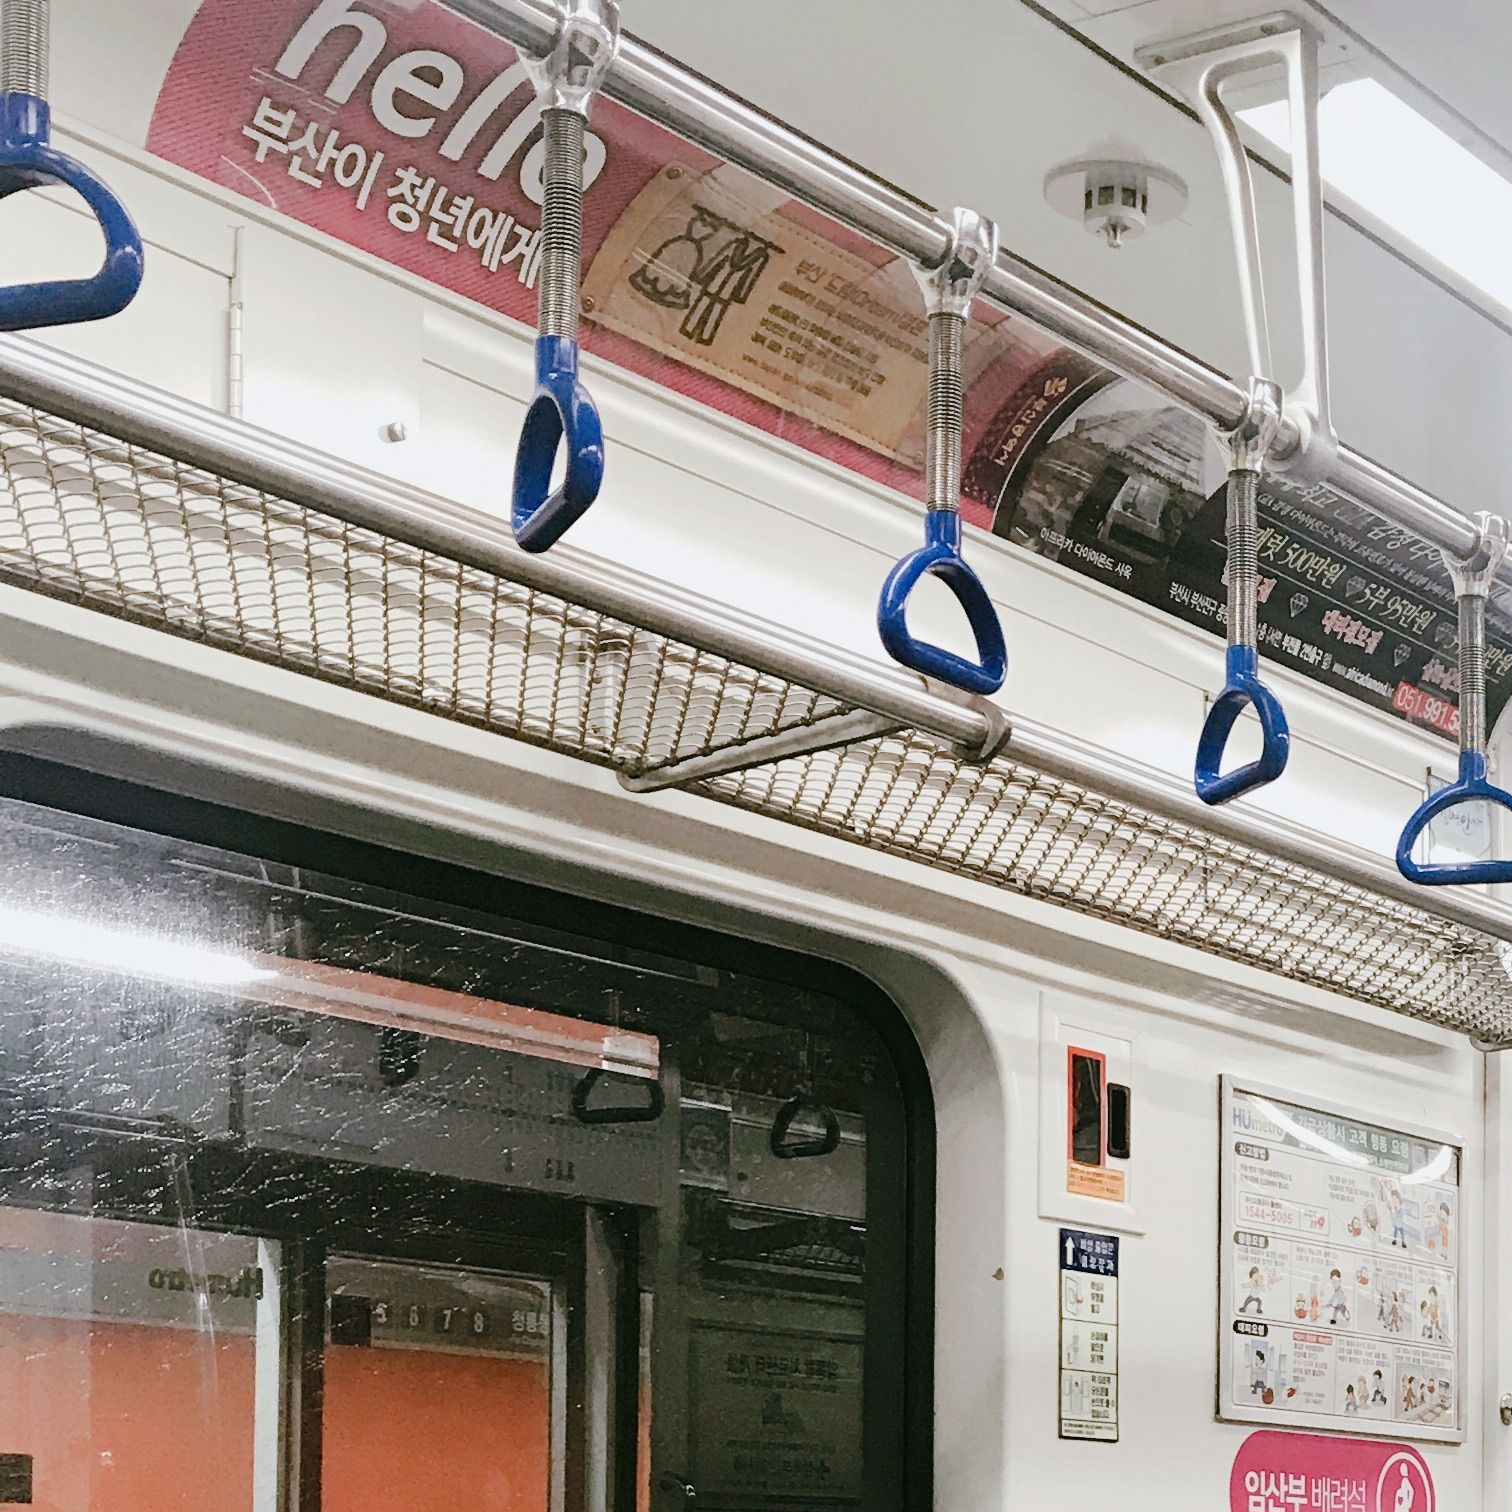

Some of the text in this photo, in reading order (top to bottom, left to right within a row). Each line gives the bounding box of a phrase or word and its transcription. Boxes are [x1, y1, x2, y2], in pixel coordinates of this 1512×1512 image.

[276, 0, 608, 205] hello
[242, 96, 542, 290] 부산이 청년에게
[1040, 527, 1073, 551] 아프리카
[1074, 543, 1114, 571] 다이아몬드
[1279, 538, 1347, 590] 500만원
[1381, 601, 1437, 635] 95만원
[1397, 685, 1460, 731] 051.991.5
[1245, 1205, 1294, 1225] 1544-5005
